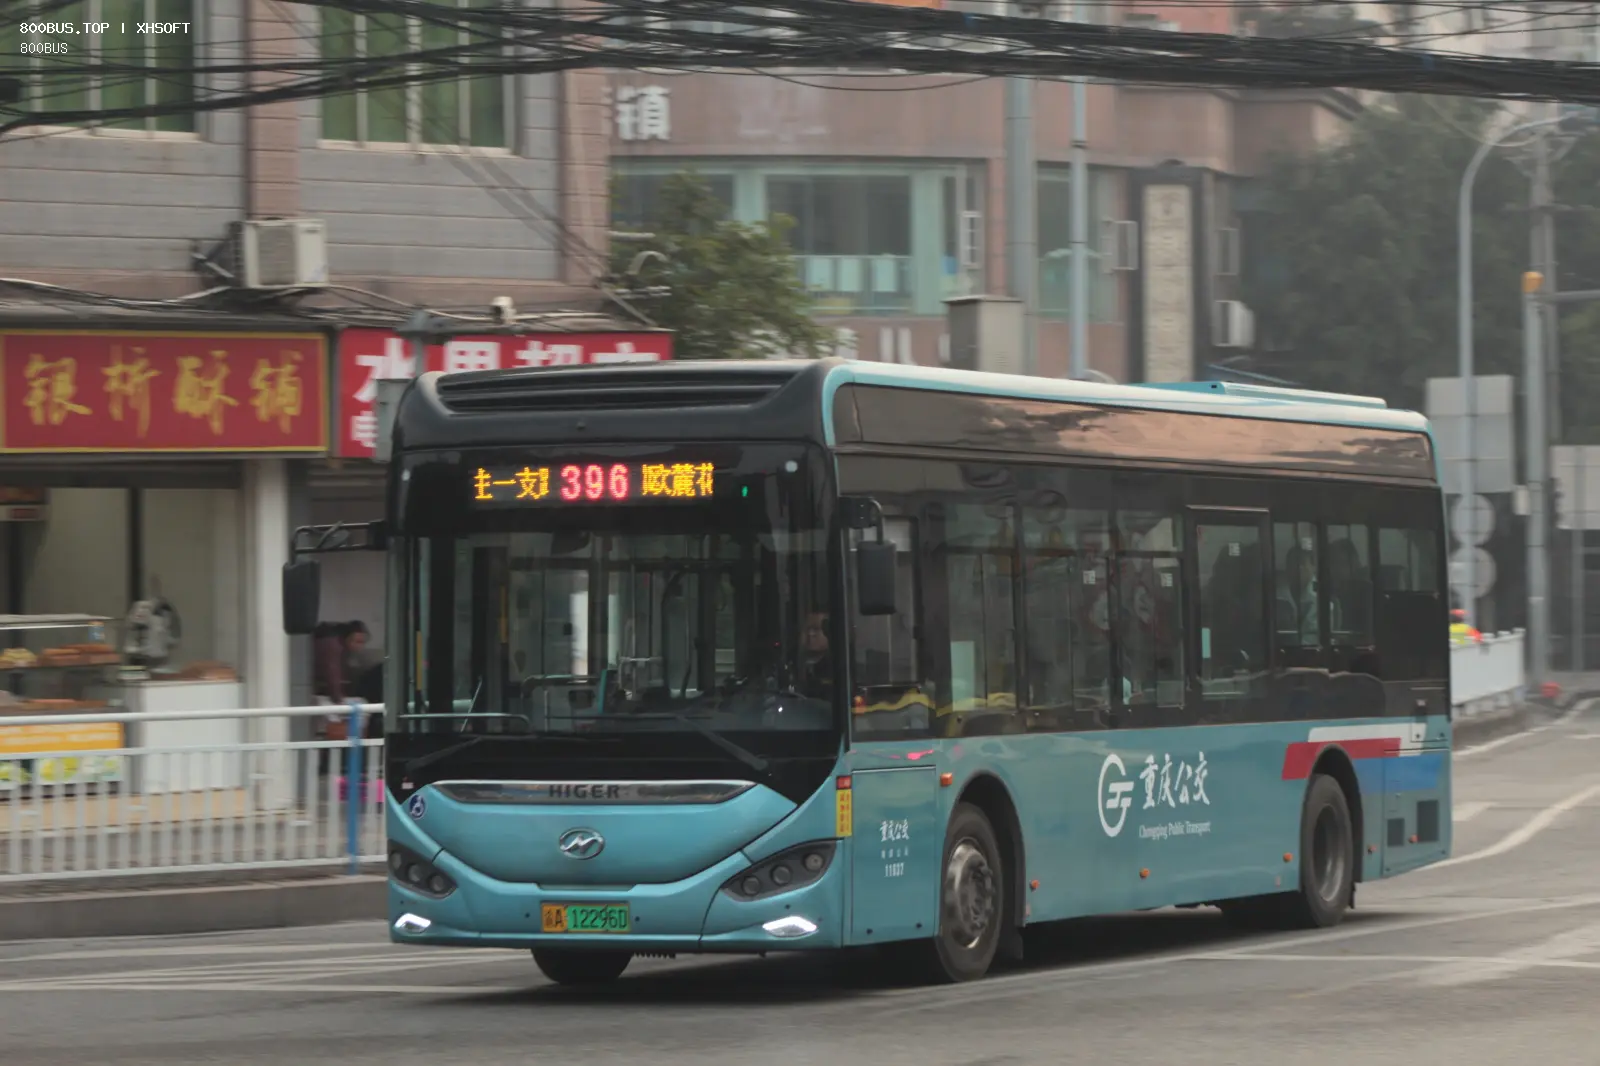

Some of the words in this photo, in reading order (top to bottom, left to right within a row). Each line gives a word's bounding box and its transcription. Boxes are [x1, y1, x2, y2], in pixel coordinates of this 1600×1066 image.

[560, 463, 630, 500] 396
[548, 784, 620, 799] HIGER
[1139, 751, 1211, 810] 重庆公交
